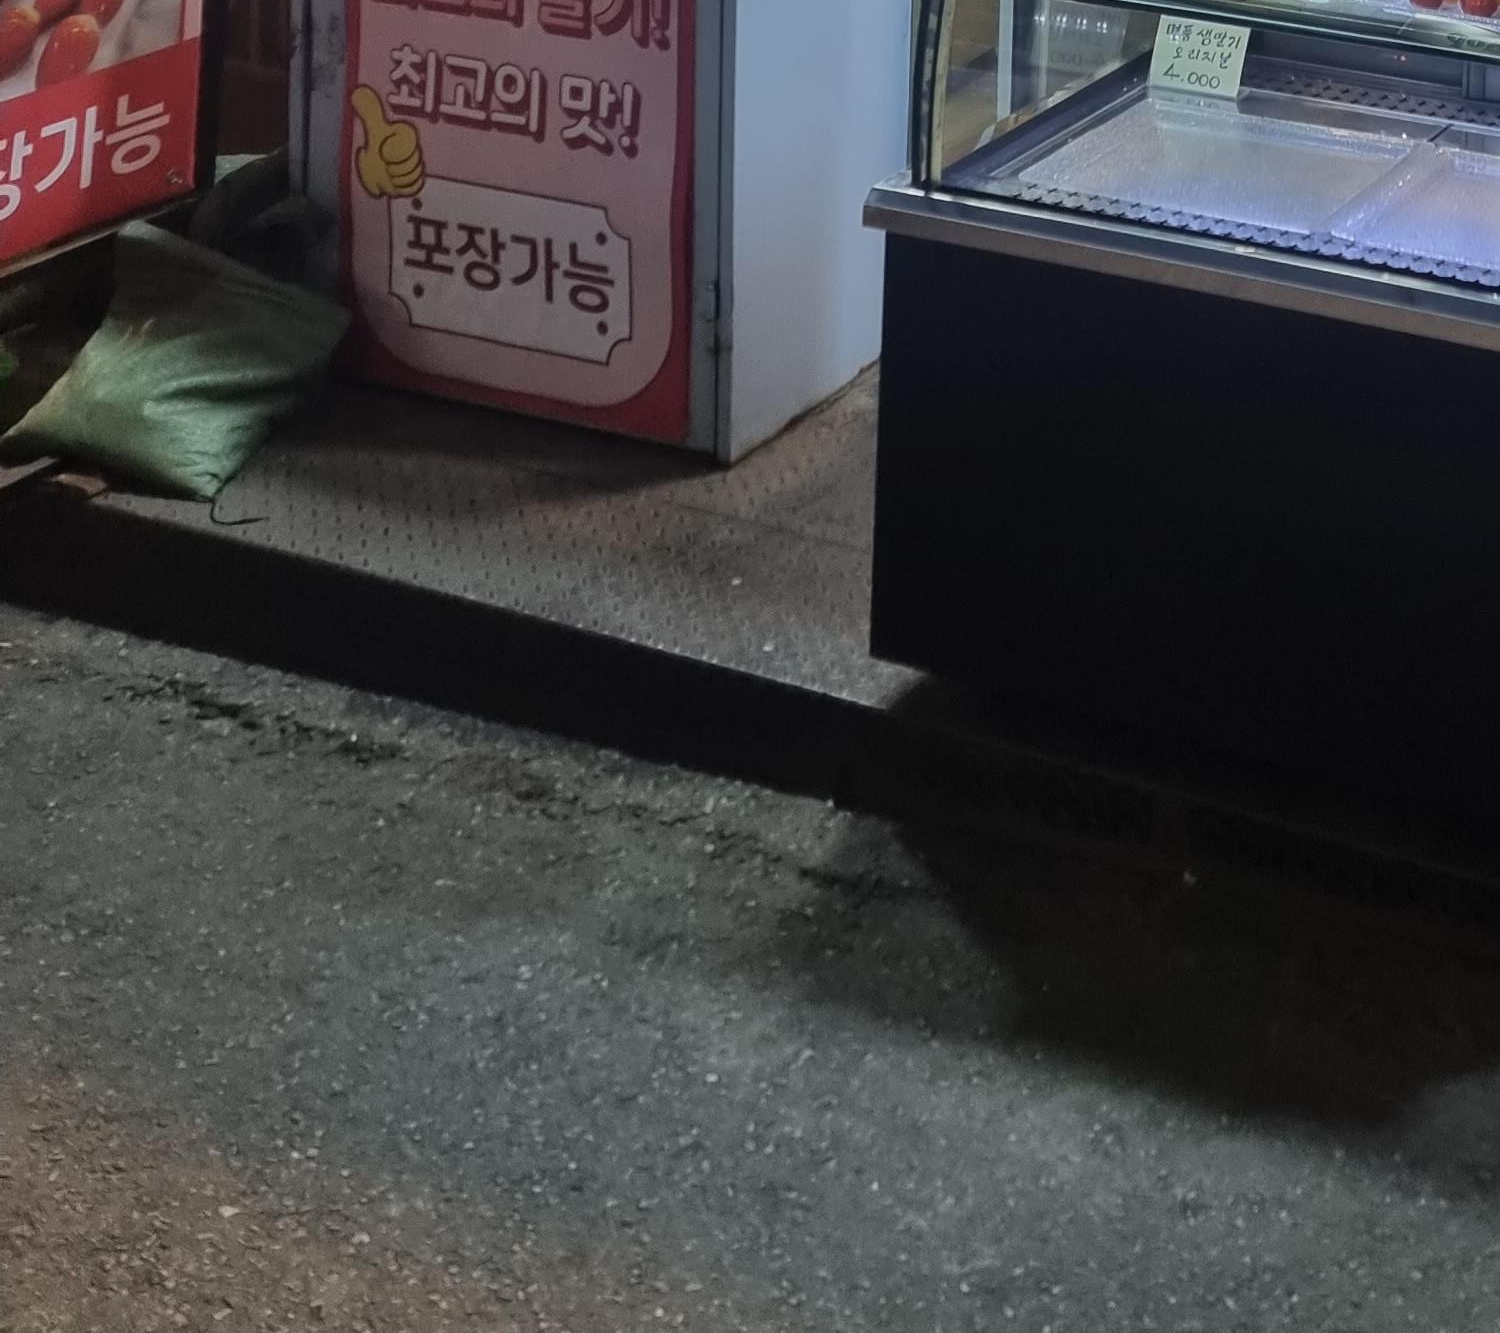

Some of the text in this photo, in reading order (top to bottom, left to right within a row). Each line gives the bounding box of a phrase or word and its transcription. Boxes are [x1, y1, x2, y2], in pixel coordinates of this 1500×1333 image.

[387, 42, 641, 159] 최고의 맛!
[404, 213, 615, 315] 포장가능
